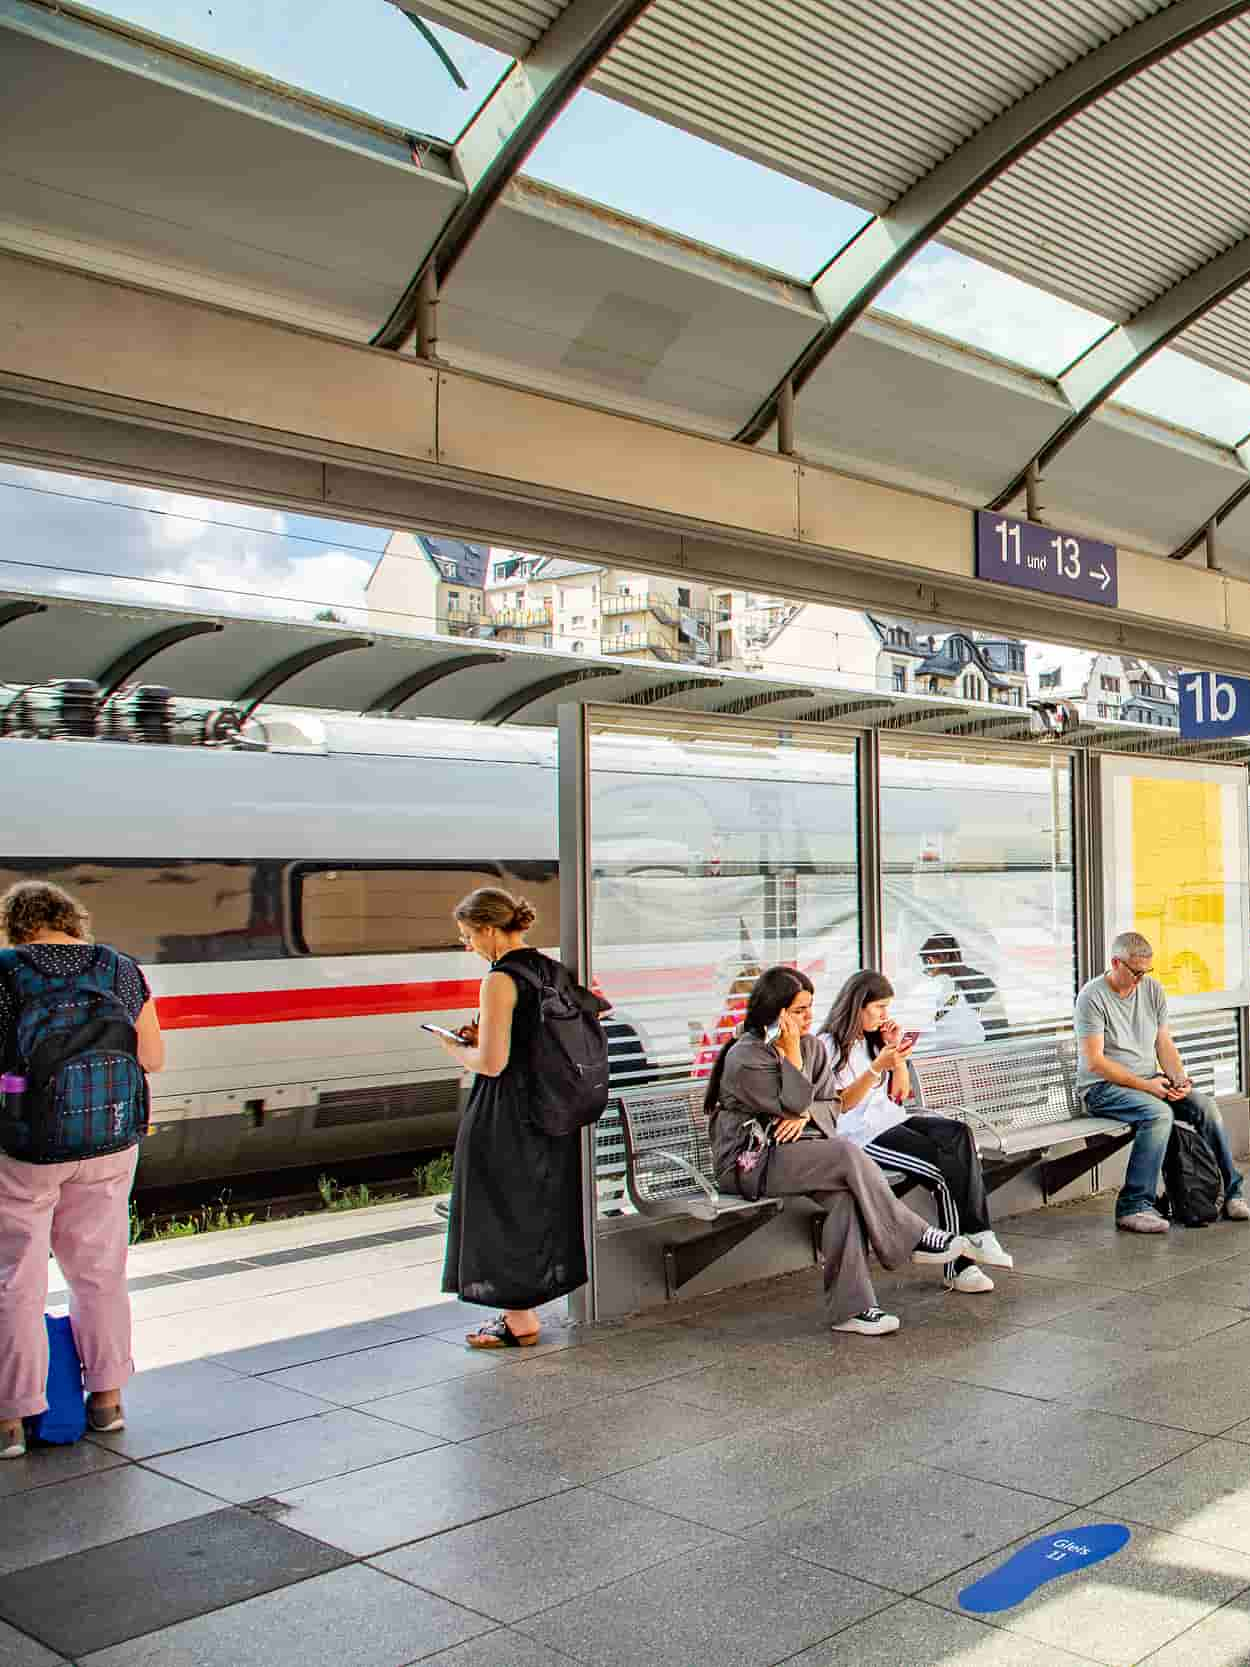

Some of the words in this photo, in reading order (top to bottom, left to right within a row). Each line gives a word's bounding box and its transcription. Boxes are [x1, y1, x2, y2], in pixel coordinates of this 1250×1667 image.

[995, 520, 1021, 565] 11
[1027, 554, 1047, 571] und
[1050, 535, 1081, 579] 13
[1185, 672, 1236, 722] 1b
[1052, 1539, 1091, 1556] Gleis
